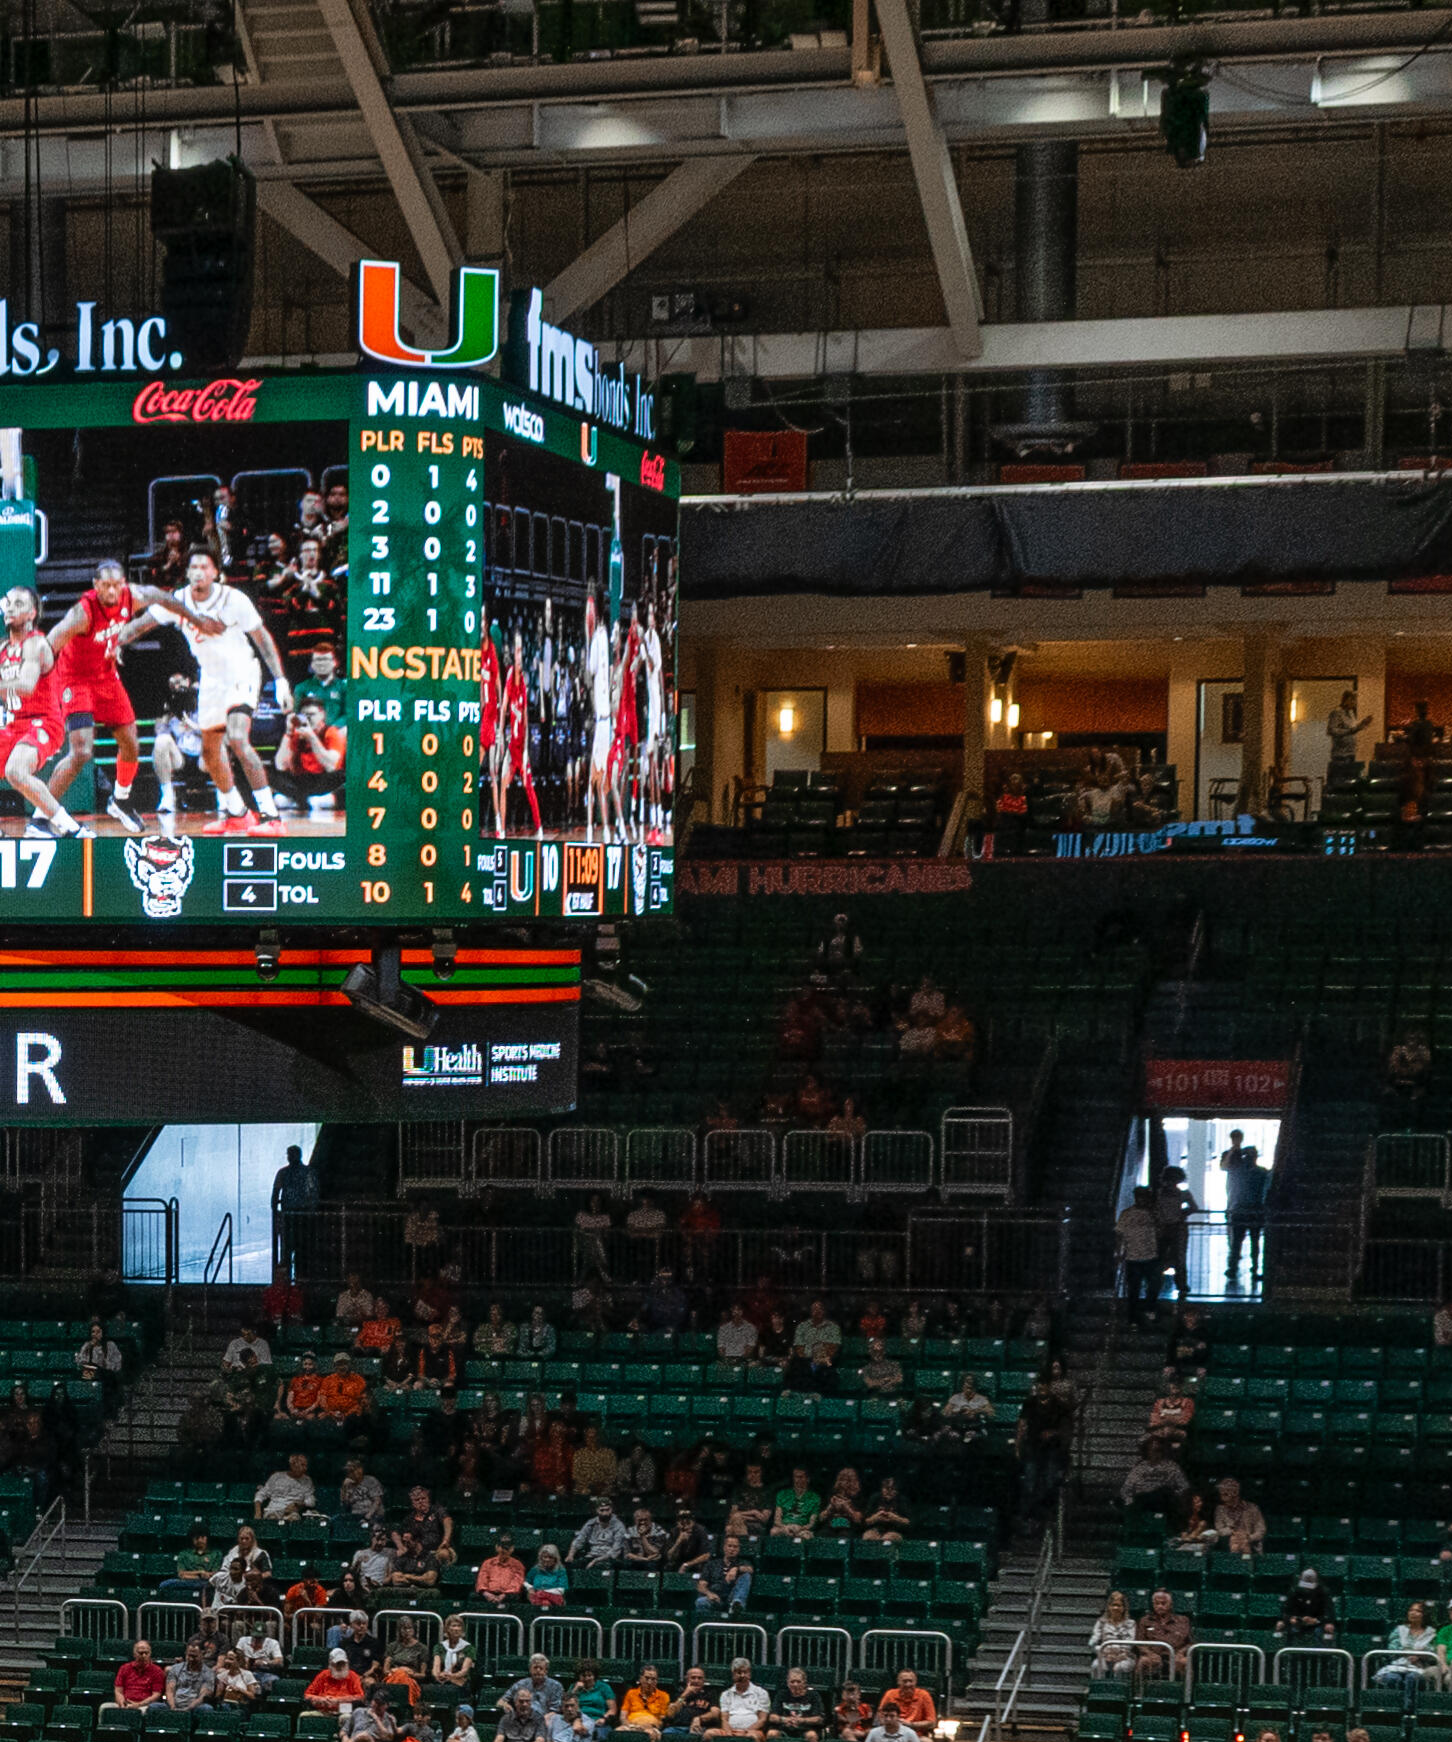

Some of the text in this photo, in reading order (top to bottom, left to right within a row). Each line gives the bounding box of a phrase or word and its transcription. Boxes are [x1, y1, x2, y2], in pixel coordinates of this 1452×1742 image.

[76, 301, 183, 373] Inc.
[367, 381, 480, 421] MIAMI
[361, 431, 484, 459] PLR FLS PTS
[371, 464, 478, 492] 0 1 4
[372, 500, 477, 527] 2 0 0
[372, 536, 477, 563] 3 0 2
[372, 572, 477, 598] 11 1 3
[363, 607, 476, 634] 23 1 0
[358, 700, 481, 722] PLR FLS PTS
[372, 733, 474, 757] 1 0 0
[367, 769, 474, 793] 4 0 2
[370, 807, 473, 830] 7 0 0
[240, 849, 345, 871] 2 FOULS
[368, 843, 437, 866] 8 0
[568, 848, 598, 884] 11:09
[543, 845, 559, 891] 10
[607, 847, 622, 889] 17
[749, 864, 973, 896] HURRICANES
[240, 885, 319, 903] 4 TOL
[362, 880, 472, 903] 10 1 4
[491, 1044, 529, 1062] SPORTS
[1163, 1073, 1199, 1093] 101
[1234, 1074, 1271, 1093] 102
